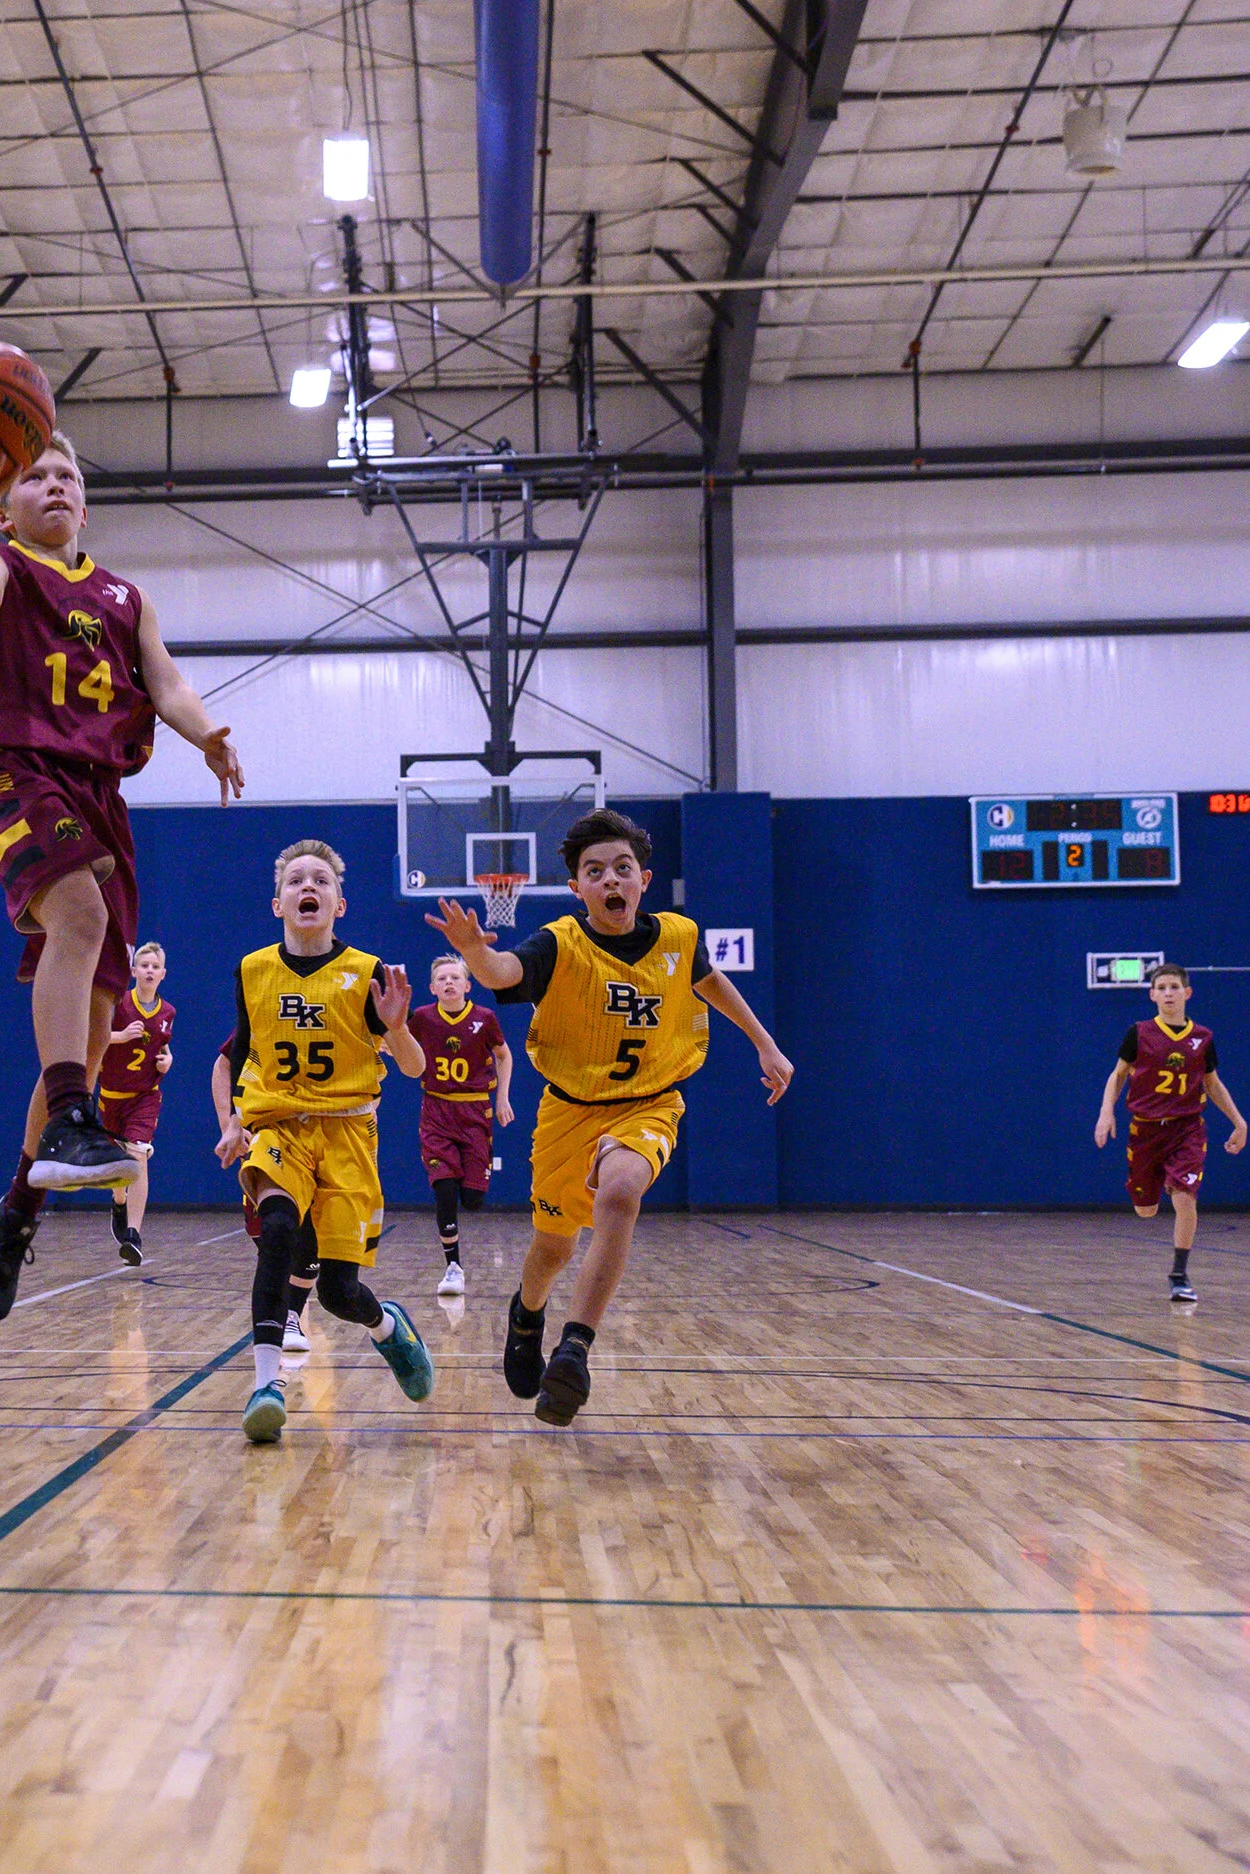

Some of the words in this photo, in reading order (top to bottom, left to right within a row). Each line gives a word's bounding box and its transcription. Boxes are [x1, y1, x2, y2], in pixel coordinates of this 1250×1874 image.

[45, 652, 115, 713] 14
[989, 833, 1025, 848] HOME
[1122, 831, 1162, 846] GUEST
[1067, 844, 1082, 868] 2
[715, 936, 746, 964] #1
[278, 994, 326, 1030] BK
[605, 981, 662, 1029] BK
[126, 1048, 146, 1071] 2
[274, 1041, 335, 1082] 35
[435, 1056, 469, 1083] 30
[608, 1039, 647, 1081] 5
[1154, 1070, 1188, 1096] 21
[538, 1198, 564, 1217] BK
